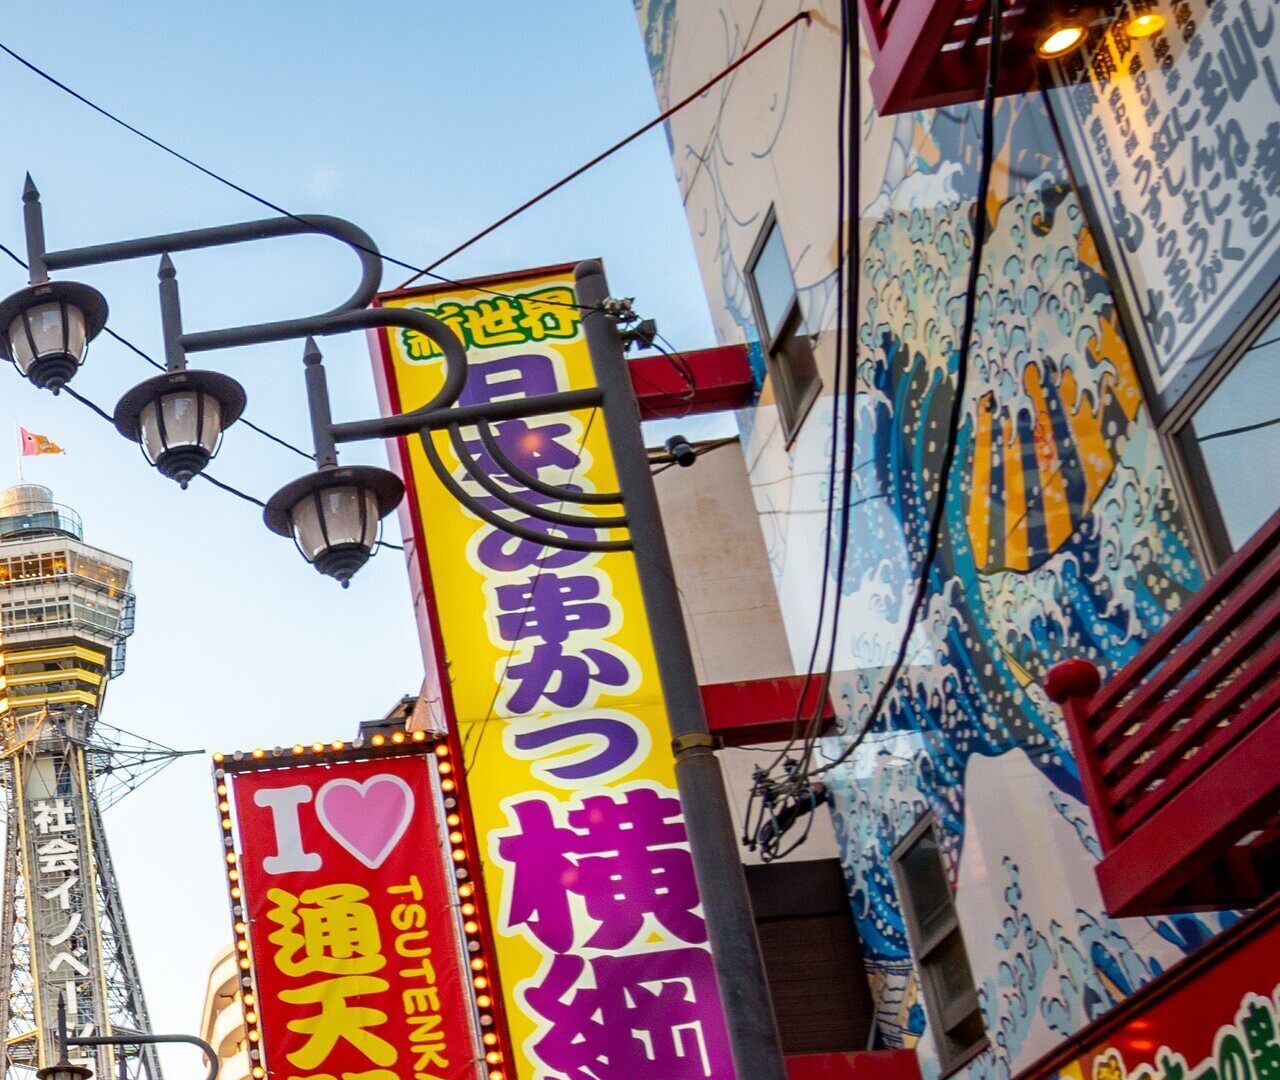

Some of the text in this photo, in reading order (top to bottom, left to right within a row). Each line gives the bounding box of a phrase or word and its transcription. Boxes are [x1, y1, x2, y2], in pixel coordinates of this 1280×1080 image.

[402, 285, 583, 361] 新世界
[253, 784, 323, 875] I
